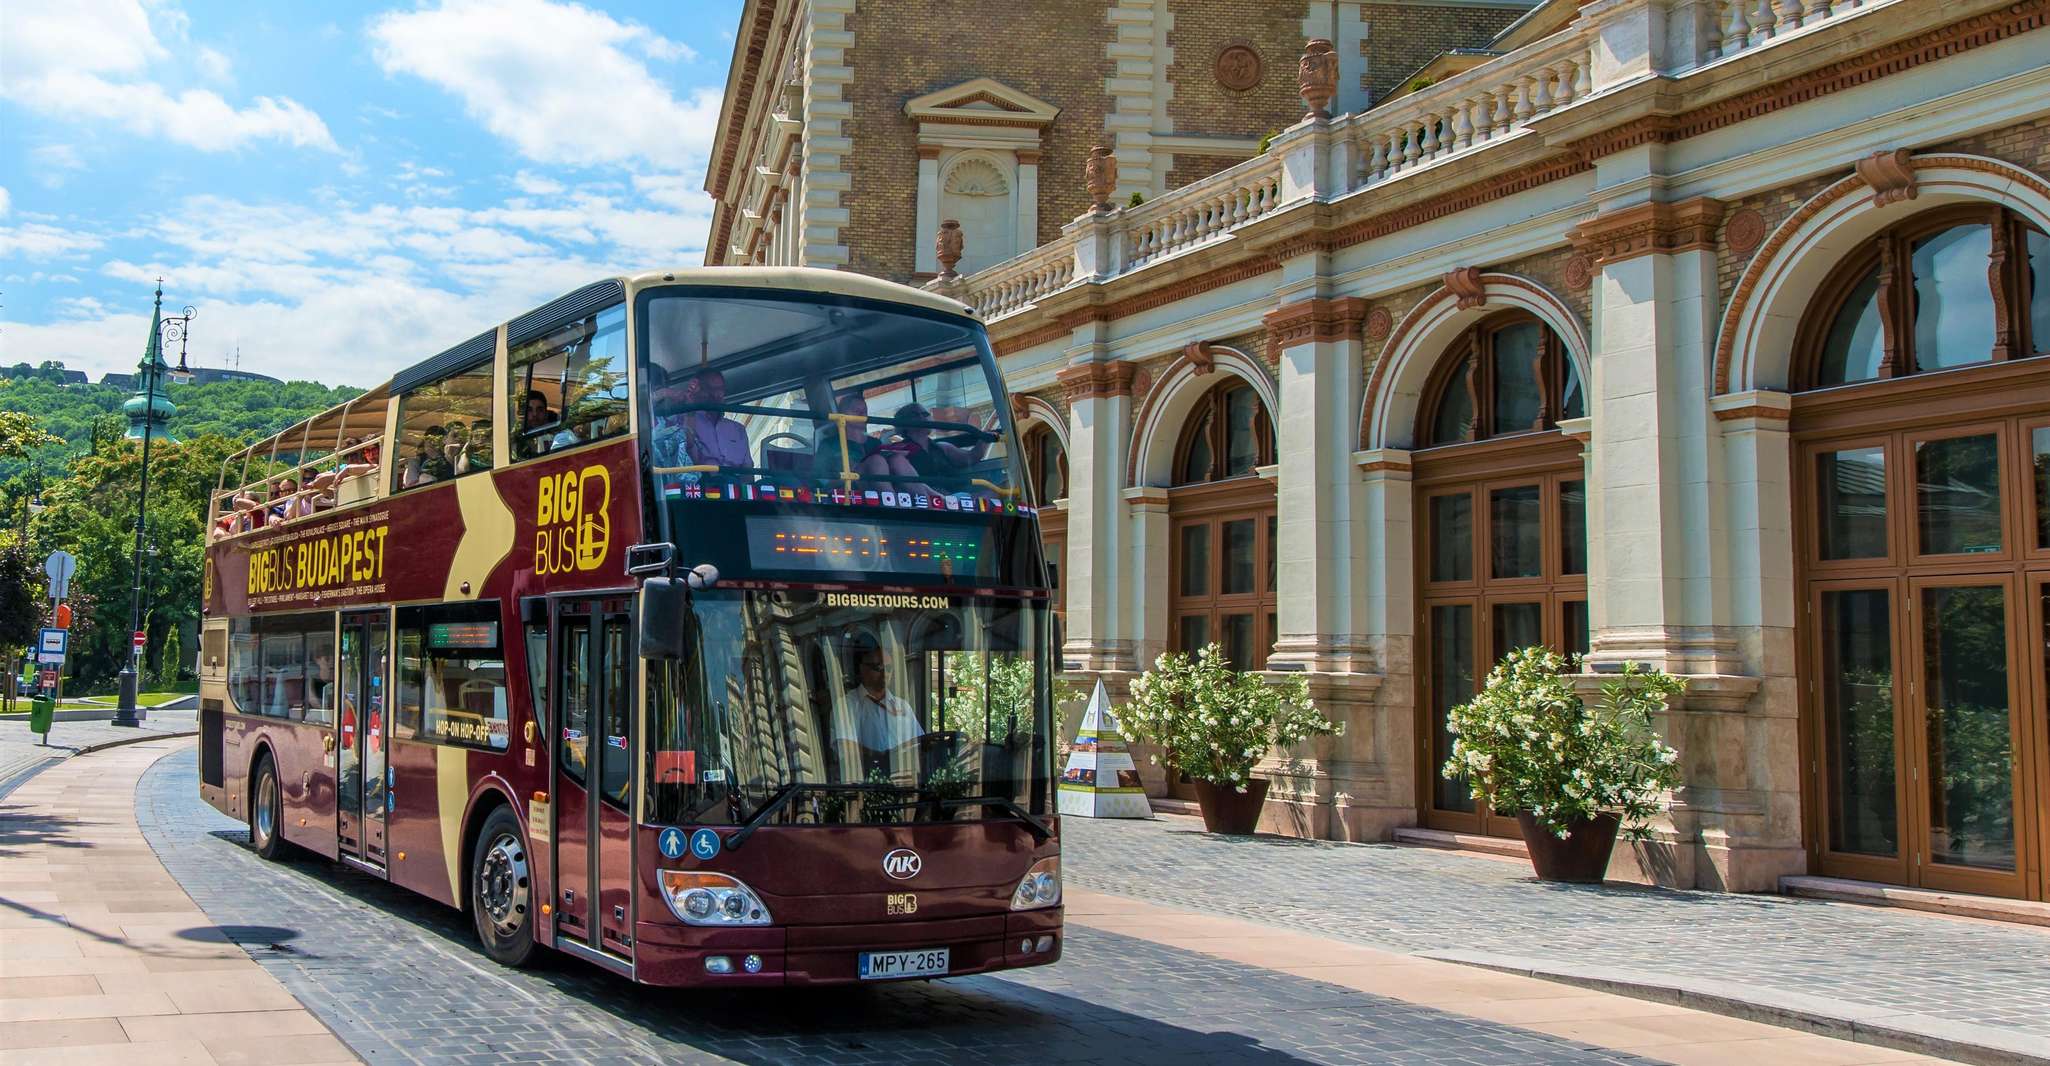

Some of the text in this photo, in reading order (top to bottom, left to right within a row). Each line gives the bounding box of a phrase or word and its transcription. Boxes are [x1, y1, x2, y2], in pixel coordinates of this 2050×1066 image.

[537, 470, 578, 526] BIG
[296, 525, 389, 589] BUDAPEST
[535, 526, 575, 575] BUS
[827, 593, 949, 609] BIGBUSTOURS.COM
[435, 719, 460, 737] HOP-ON
[460, 722, 489, 742] HOP-OFF
[887, 894, 904, 905] BIG
[887, 905, 904, 915] BUS
[872, 951, 945, 973] MPY-265
